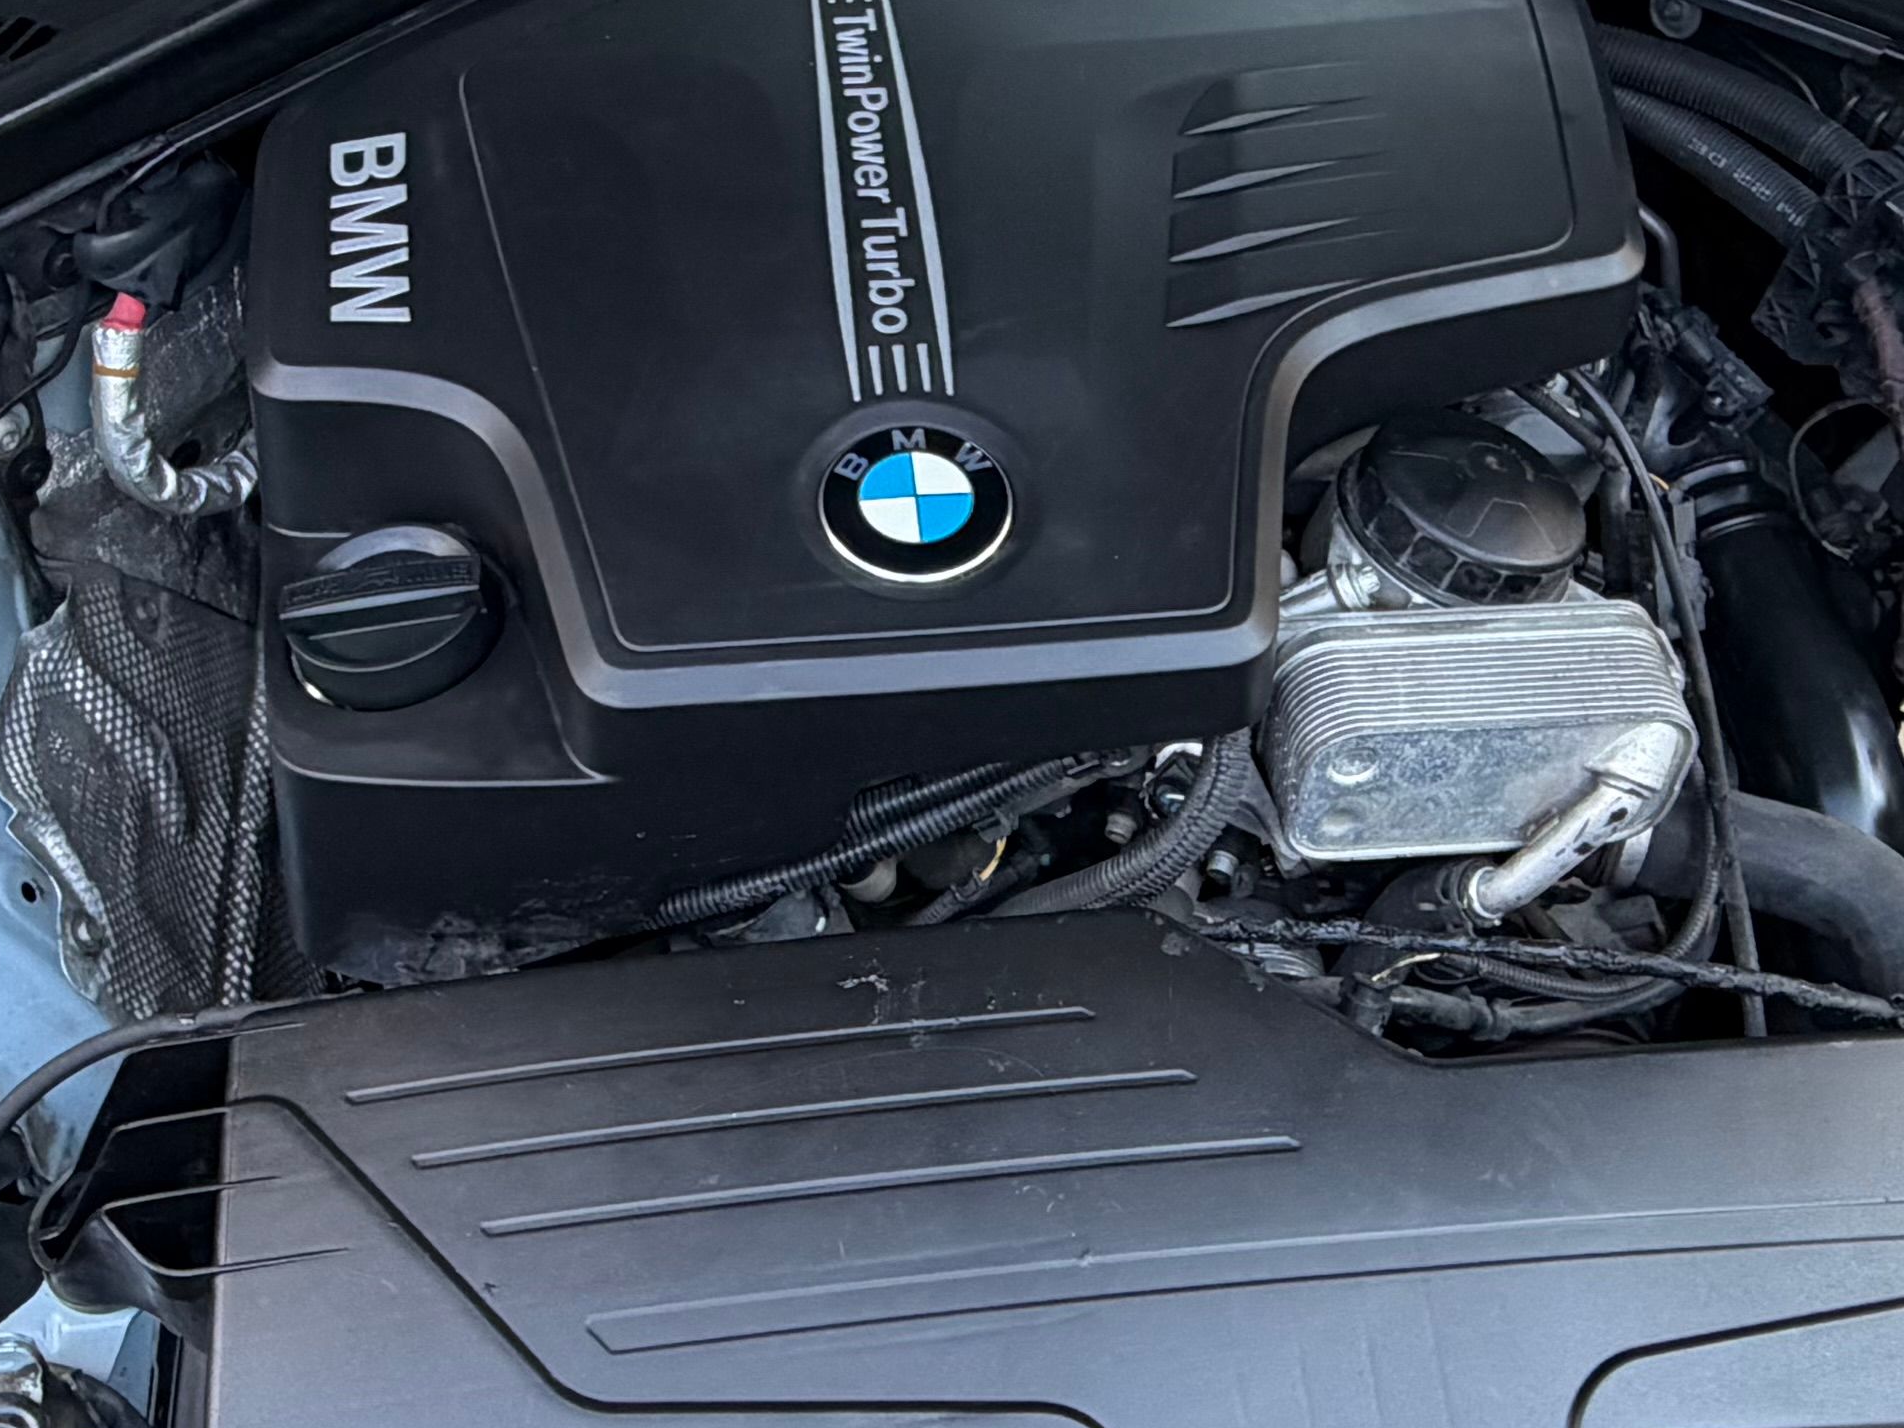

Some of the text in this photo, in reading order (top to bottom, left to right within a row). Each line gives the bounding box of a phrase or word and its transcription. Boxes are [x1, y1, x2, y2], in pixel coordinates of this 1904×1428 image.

[328, 131, 412, 324] BMW
[832, 8, 916, 335] TwinPower Turbo
[833, 428, 994, 482] BMW
